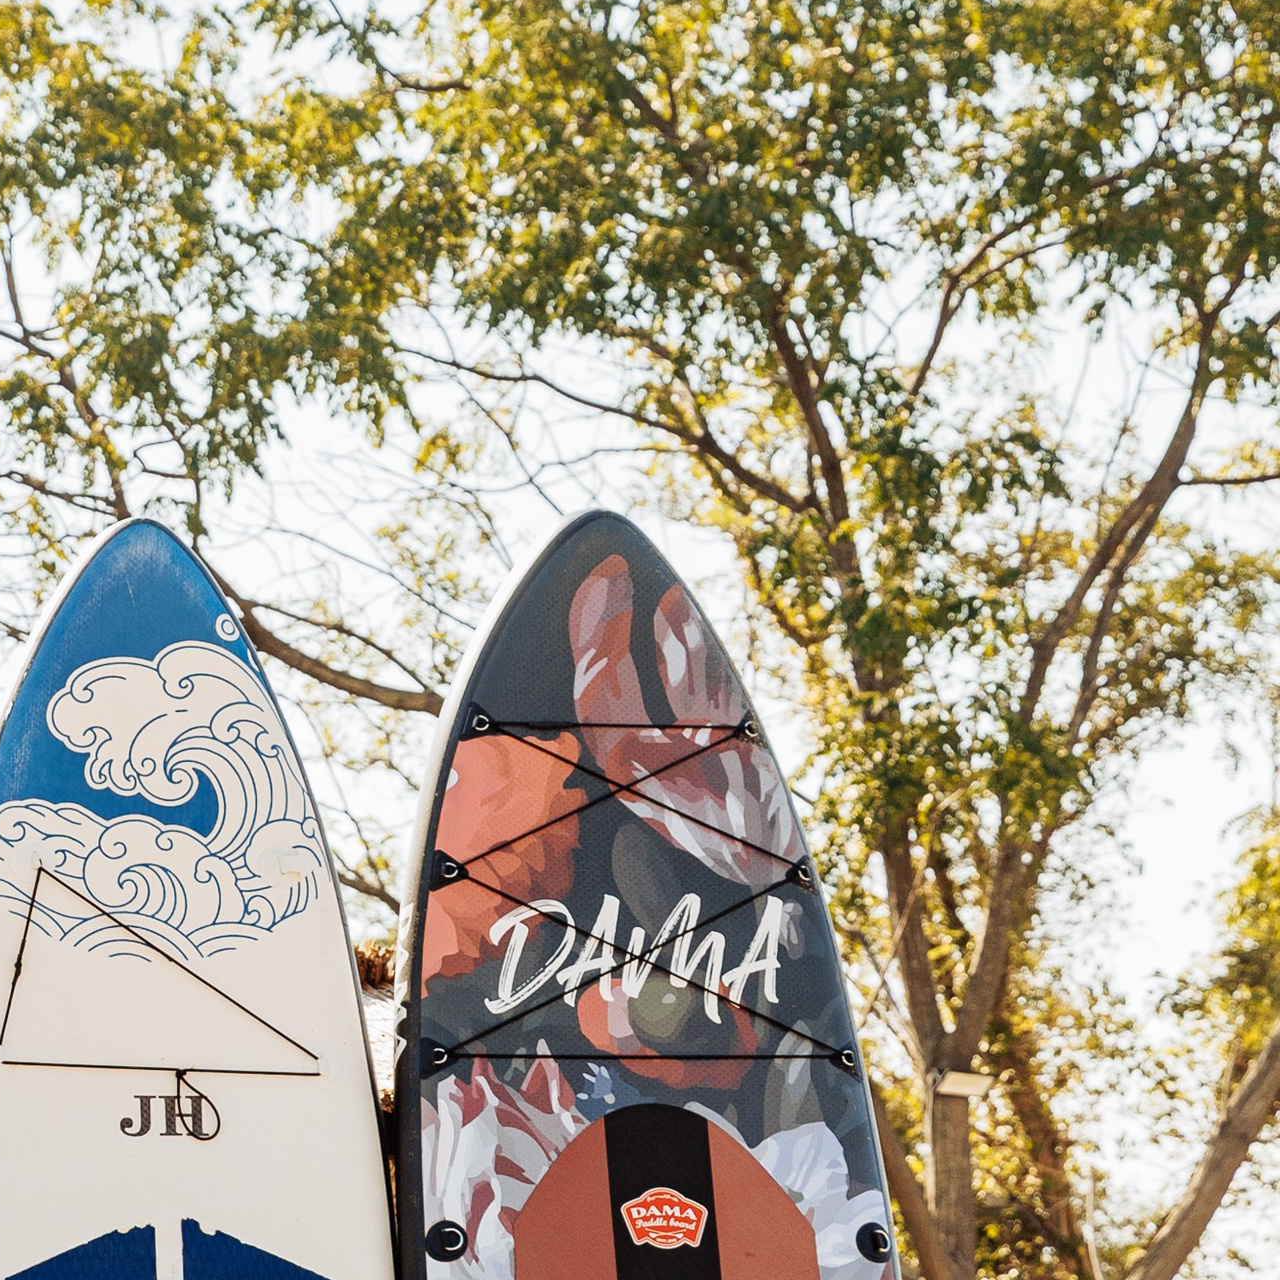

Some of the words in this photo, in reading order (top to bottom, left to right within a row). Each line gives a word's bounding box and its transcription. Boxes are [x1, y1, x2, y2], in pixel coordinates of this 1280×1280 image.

[483, 892, 785, 1025] DAMA
[120, 1095, 210, 1137] JH
[630, 1204, 698, 1221] DAMA
[635, 1217, 668, 1229] Paddle
